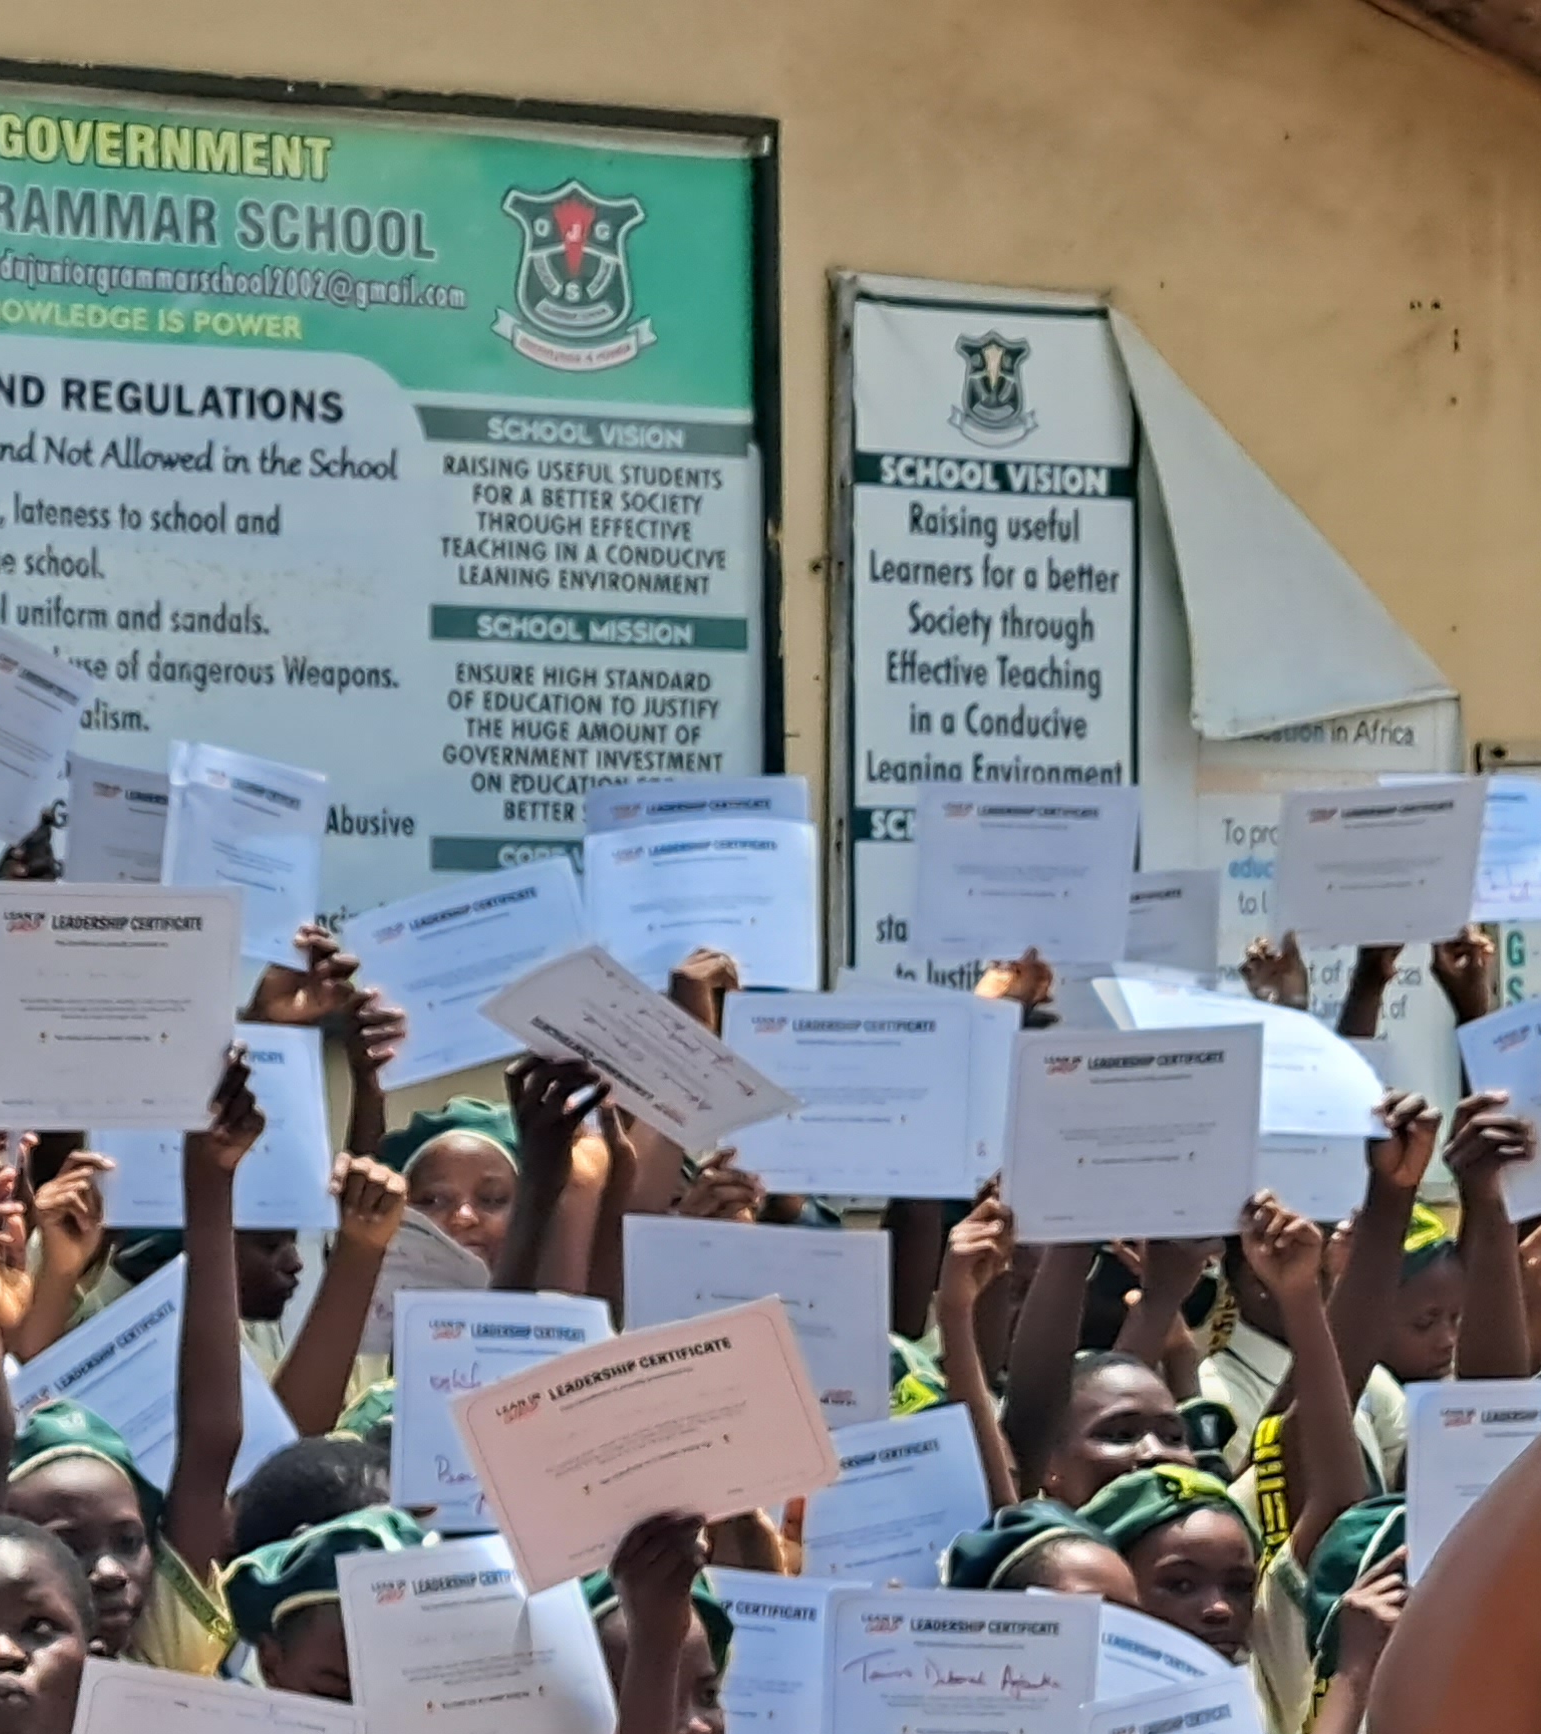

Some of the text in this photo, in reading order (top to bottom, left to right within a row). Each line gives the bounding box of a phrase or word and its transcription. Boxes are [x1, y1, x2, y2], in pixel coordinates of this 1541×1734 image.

[237, 201, 436, 262] SCHOOL
[157, 306, 184, 335] IS
[193, 308, 303, 341] POWER
[62, 377, 344, 423] REGULATIONS
[487, 416, 684, 448] SCHOOL VISION
[44, 437, 93, 468] Not
[101, 437, 213, 473] Allowed
[222, 446, 251, 474] in
[258, 442, 302, 477] the
[309, 447, 399, 481] School
[443, 454, 724, 490] RAISING USEFUL STUDENTS
[880, 456, 1108, 494] SCHOOL VISION
[14, 492, 110, 530] lateness
[119, 500, 142, 531] to
[150, 501, 227, 535] school
[235, 504, 282, 537] and
[473, 483, 704, 516] FOR A BETTER SOCIETY
[477, 511, 692, 541] THROUGH EFFECTIVE
[908, 502, 1079, 546] Raising useful
[24, 546, 105, 580] school.
[442, 536, 727, 571] TEACHING IN A CONDUCIVE
[459, 564, 710, 595] LEANING ENVIRONMENT
[869, 550, 1119, 594] Learners for a better
[16, 596, 108, 631] uniform
[117, 600, 162, 633] and
[170, 601, 270, 635] sandals.
[477, 614, 693, 646] SCHOOL MISSION
[908, 599, 1095, 650] Society through
[117, 653, 399, 694] of dangerous Weapons.
[455, 662, 711, 692] ENSURE HIGH STANDARD
[886, 651, 1101, 699] Effective Teaching
[448, 690, 720, 720] OF EDUCATION TO JUSTIFY
[910, 703, 1087, 740] in a Conducive
[466, 717, 701, 746] THE HUGE AMOUNT OF
[1331, 718, 1415, 748] in Africa
[442, 745, 723, 773] GOVERNMENT INVESTMENT
[973, 755, 1122, 785] Environment
[51, 915, 203, 932] LEADERSHIP CERTIFICATE
[547, 1337, 733, 1401] LEADERSHIP CERTIFICATE
[909, 1619, 1060, 1636] LEADERSHIP CERTIFICATE
